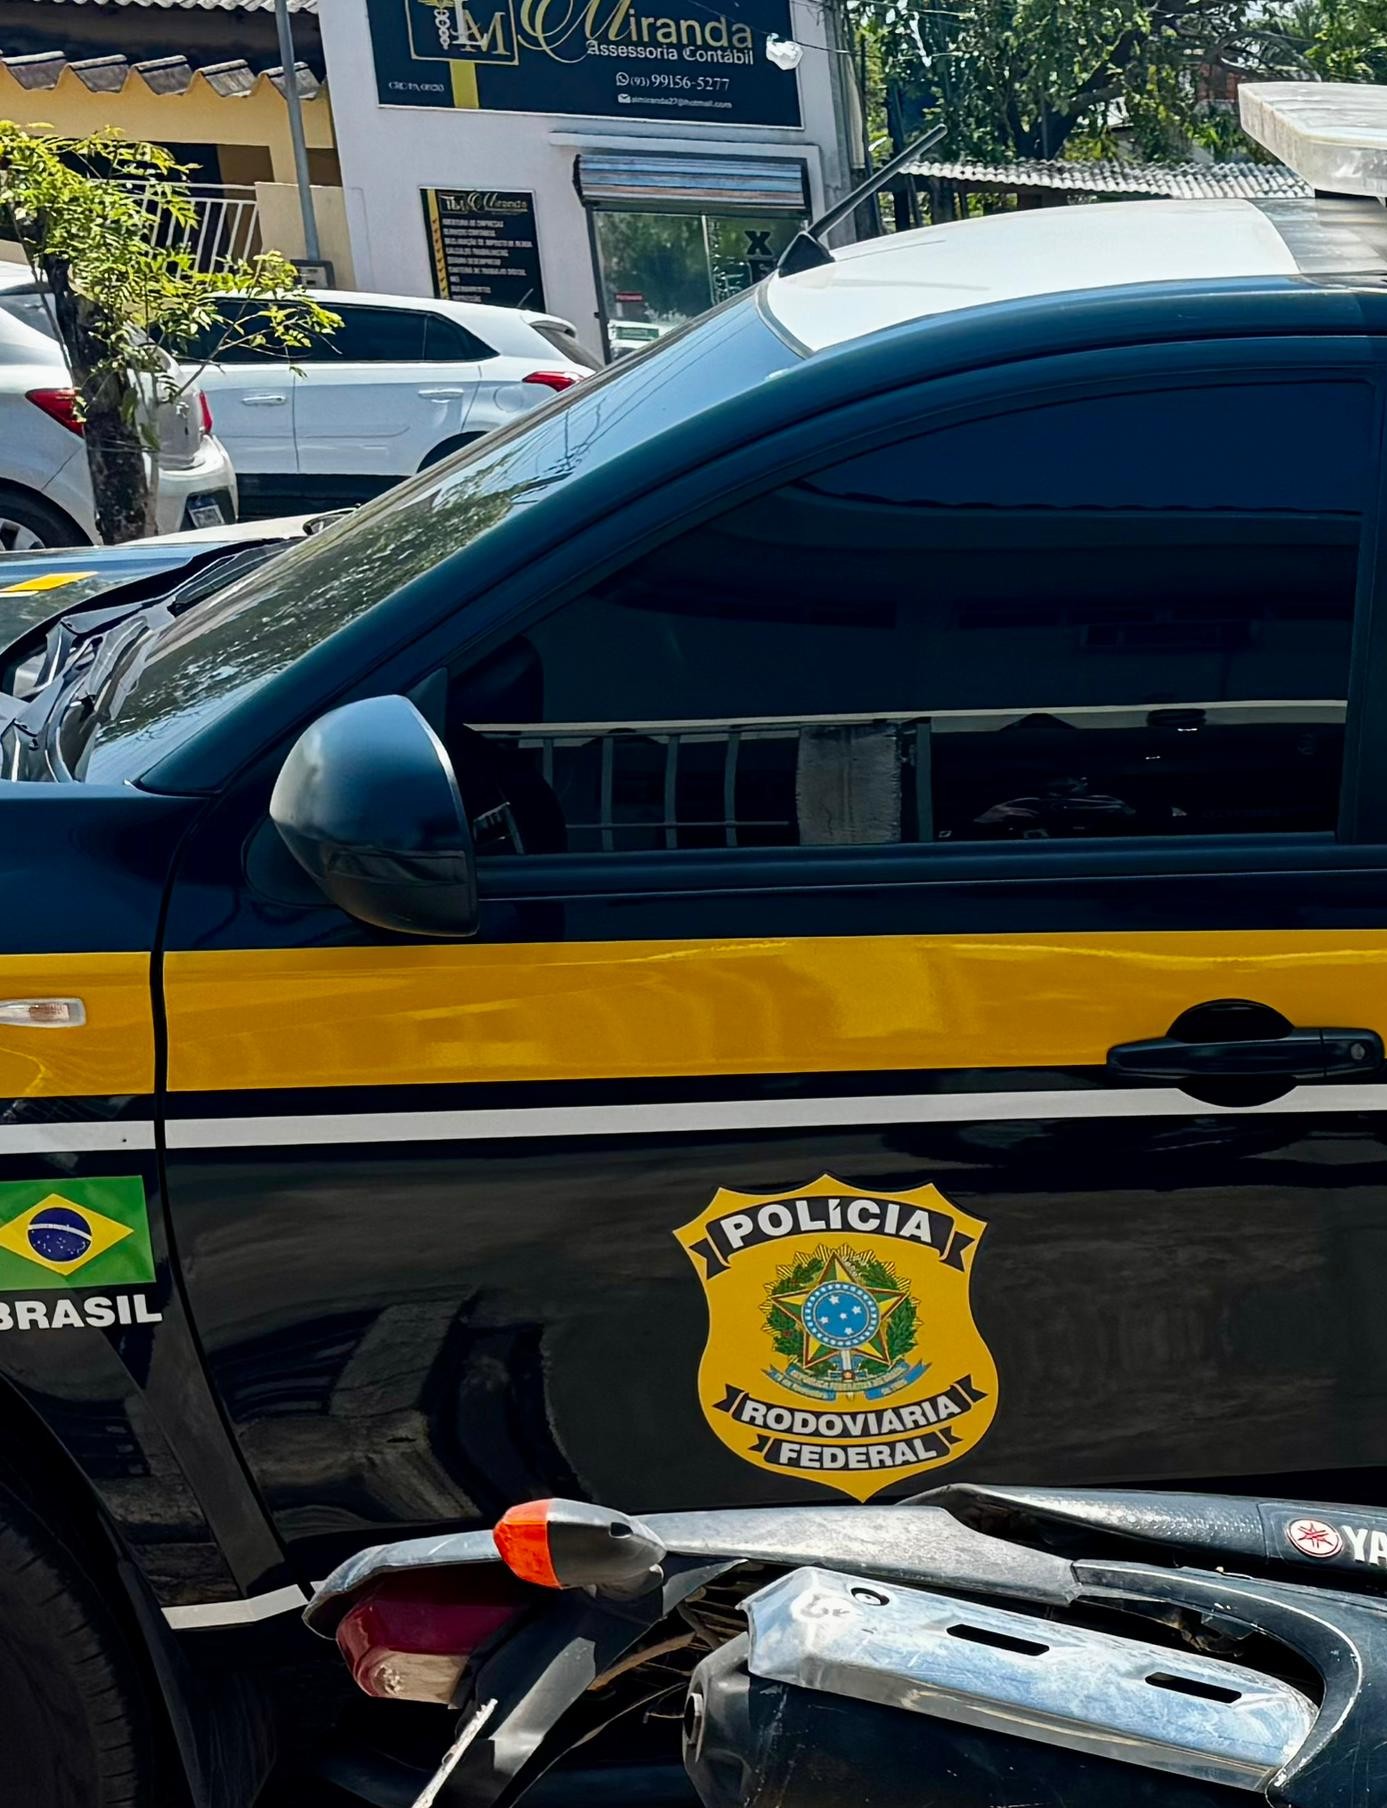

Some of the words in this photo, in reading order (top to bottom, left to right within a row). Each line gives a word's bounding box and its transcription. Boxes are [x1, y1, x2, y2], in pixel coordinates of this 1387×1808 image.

[518, 0, 753, 63] Miranda
[586, 40, 678, 60] Assessoria
[683, 47, 754, 65] Contábil
[630, 76, 650, 88] (93)
[651, 74, 730, 92] 99156-5277
[720, 1198, 932, 1249] POLÍCIA
[741, 1393, 962, 1437] RODOVIÁRIA
[778, 1439, 938, 1470] FEDERAL
